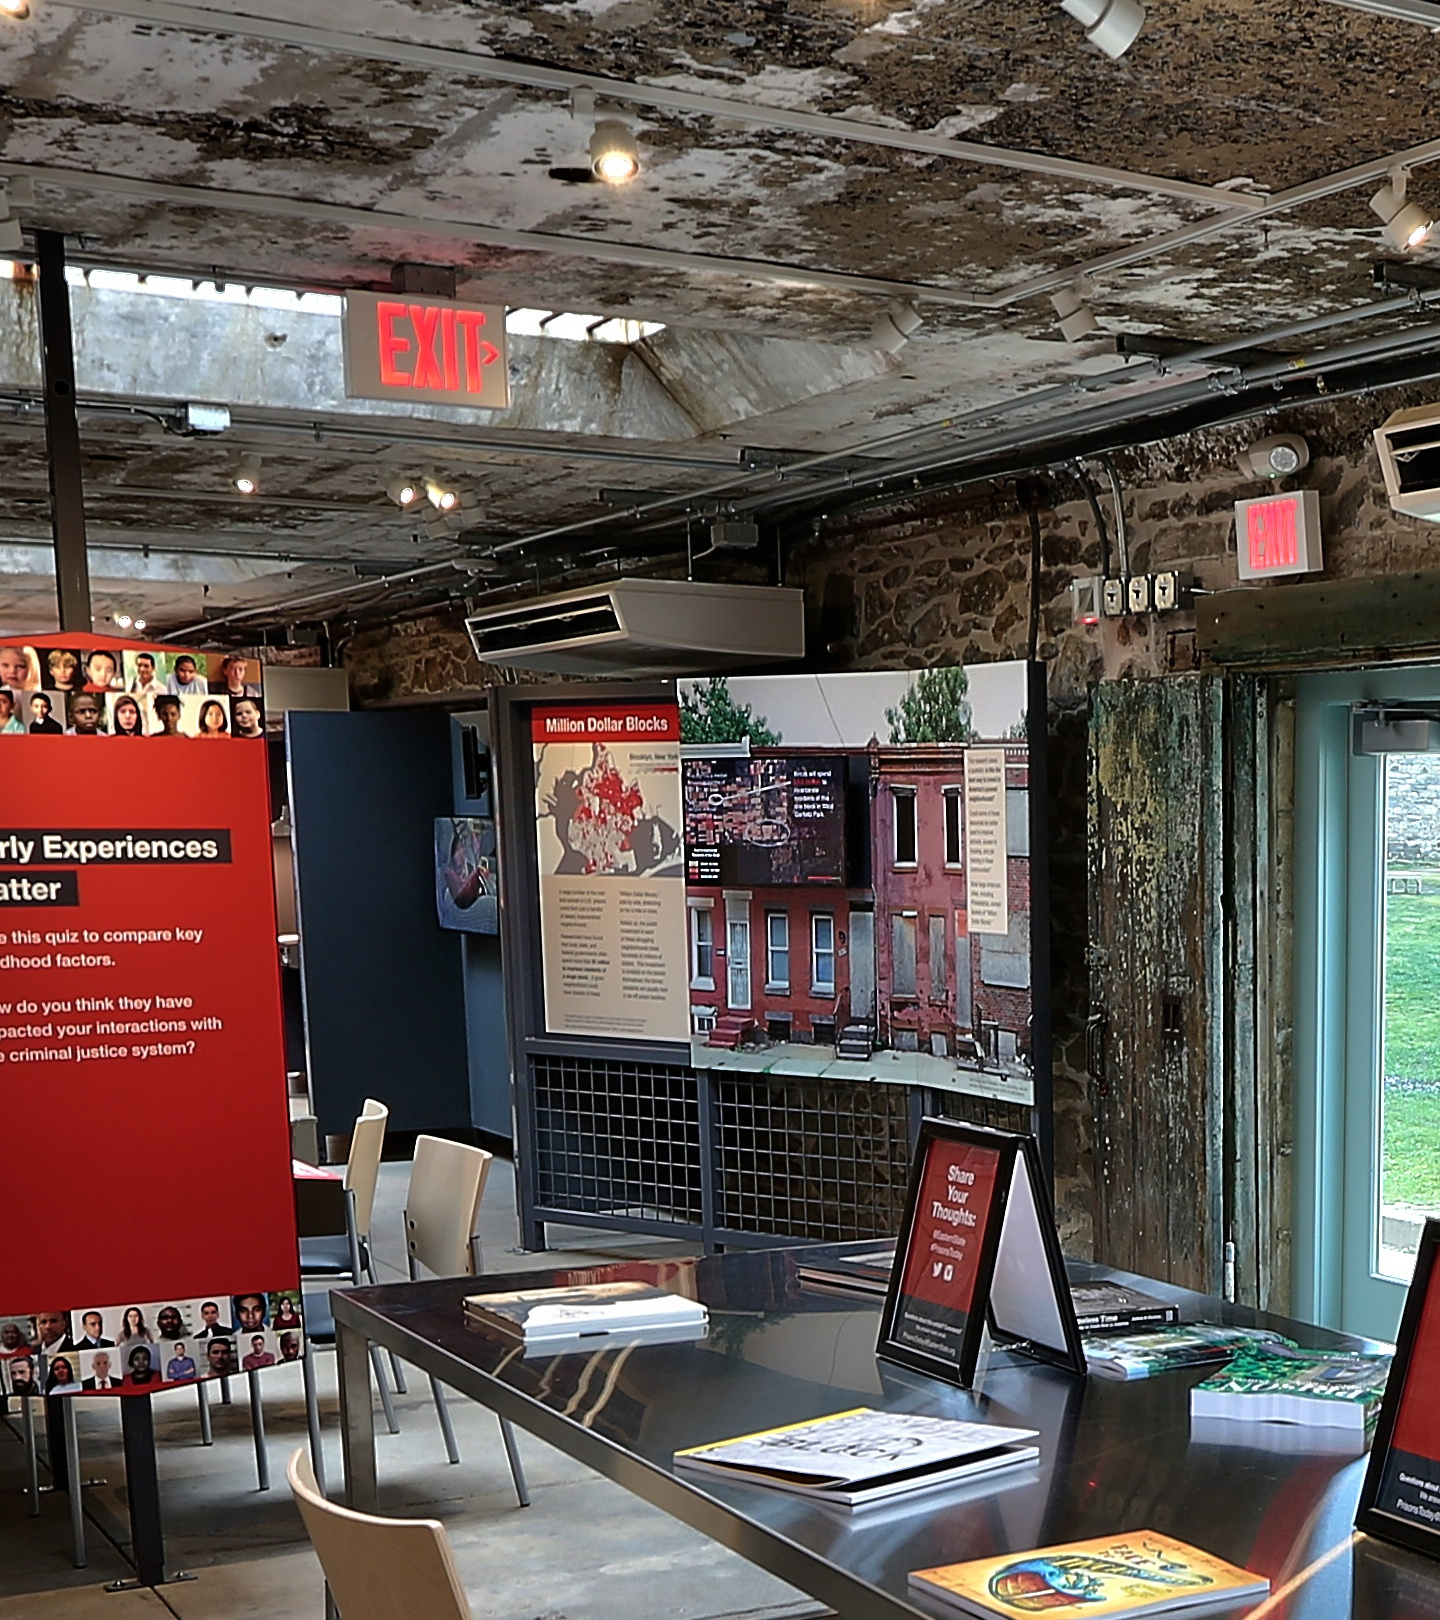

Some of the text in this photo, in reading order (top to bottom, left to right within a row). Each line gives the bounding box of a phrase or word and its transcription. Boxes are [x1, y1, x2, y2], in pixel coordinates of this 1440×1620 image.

[377, 301, 486, 393] EXIT
[546, 716, 668, 732] Million Dollar Blocks
[42, 835, 218, 863] Experiences
[11, 930, 41, 944] this
[45, 929, 79, 946] quiz
[82, 930, 99, 942] to
[103, 930, 172, 944] compare
[176, 927, 202, 943] key
[56, 954, 116, 967] factors.
[16, 1000, 38, 1013] do
[42, 1001, 71, 1016] you
[75, 997, 114, 1011] think
[118, 996, 152, 1012] they
[156, 996, 192, 1008] have
[56, 1024, 92, 1039] your
[96, 1019, 187, 1034] interactions
[190, 1016, 222, 1030] with
[9, 1046, 72, 1062] criminal
[76, 1044, 128, 1062] justice
[132, 1040, 195, 1059] system?
[948, 1165, 974, 1186] Share
[947, 1184, 969, 1204] Your
[932, 1202, 977, 1227] Thoughts:
